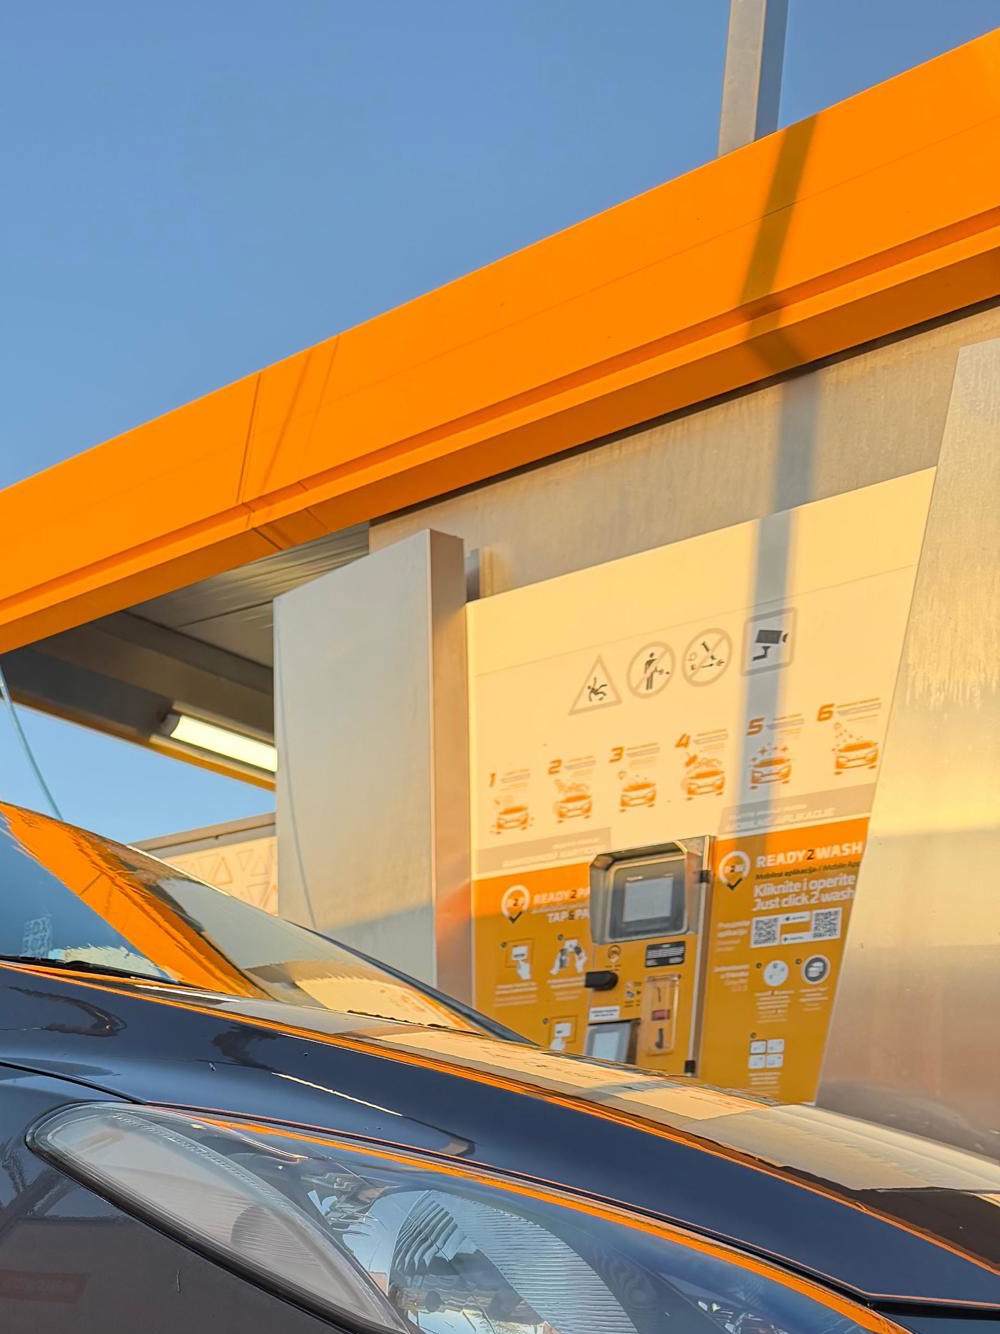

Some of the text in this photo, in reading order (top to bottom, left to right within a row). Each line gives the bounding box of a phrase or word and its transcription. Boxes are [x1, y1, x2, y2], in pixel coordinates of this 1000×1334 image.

[816, 703, 835, 722] 6
[746, 717, 765, 736] 5
[675, 733, 690, 749] 4
[609, 746, 624, 763] 3
[548, 759, 562, 775] 2
[489, 773, 496, 788] 1
[756, 841, 864, 868] READY2WASH
[754, 879, 802, 897] Kliknite
[809, 873, 856, 892] operite
[751, 898, 780, 912] Just
[781, 894, 809, 906] click
[809, 893, 820, 904] 2
